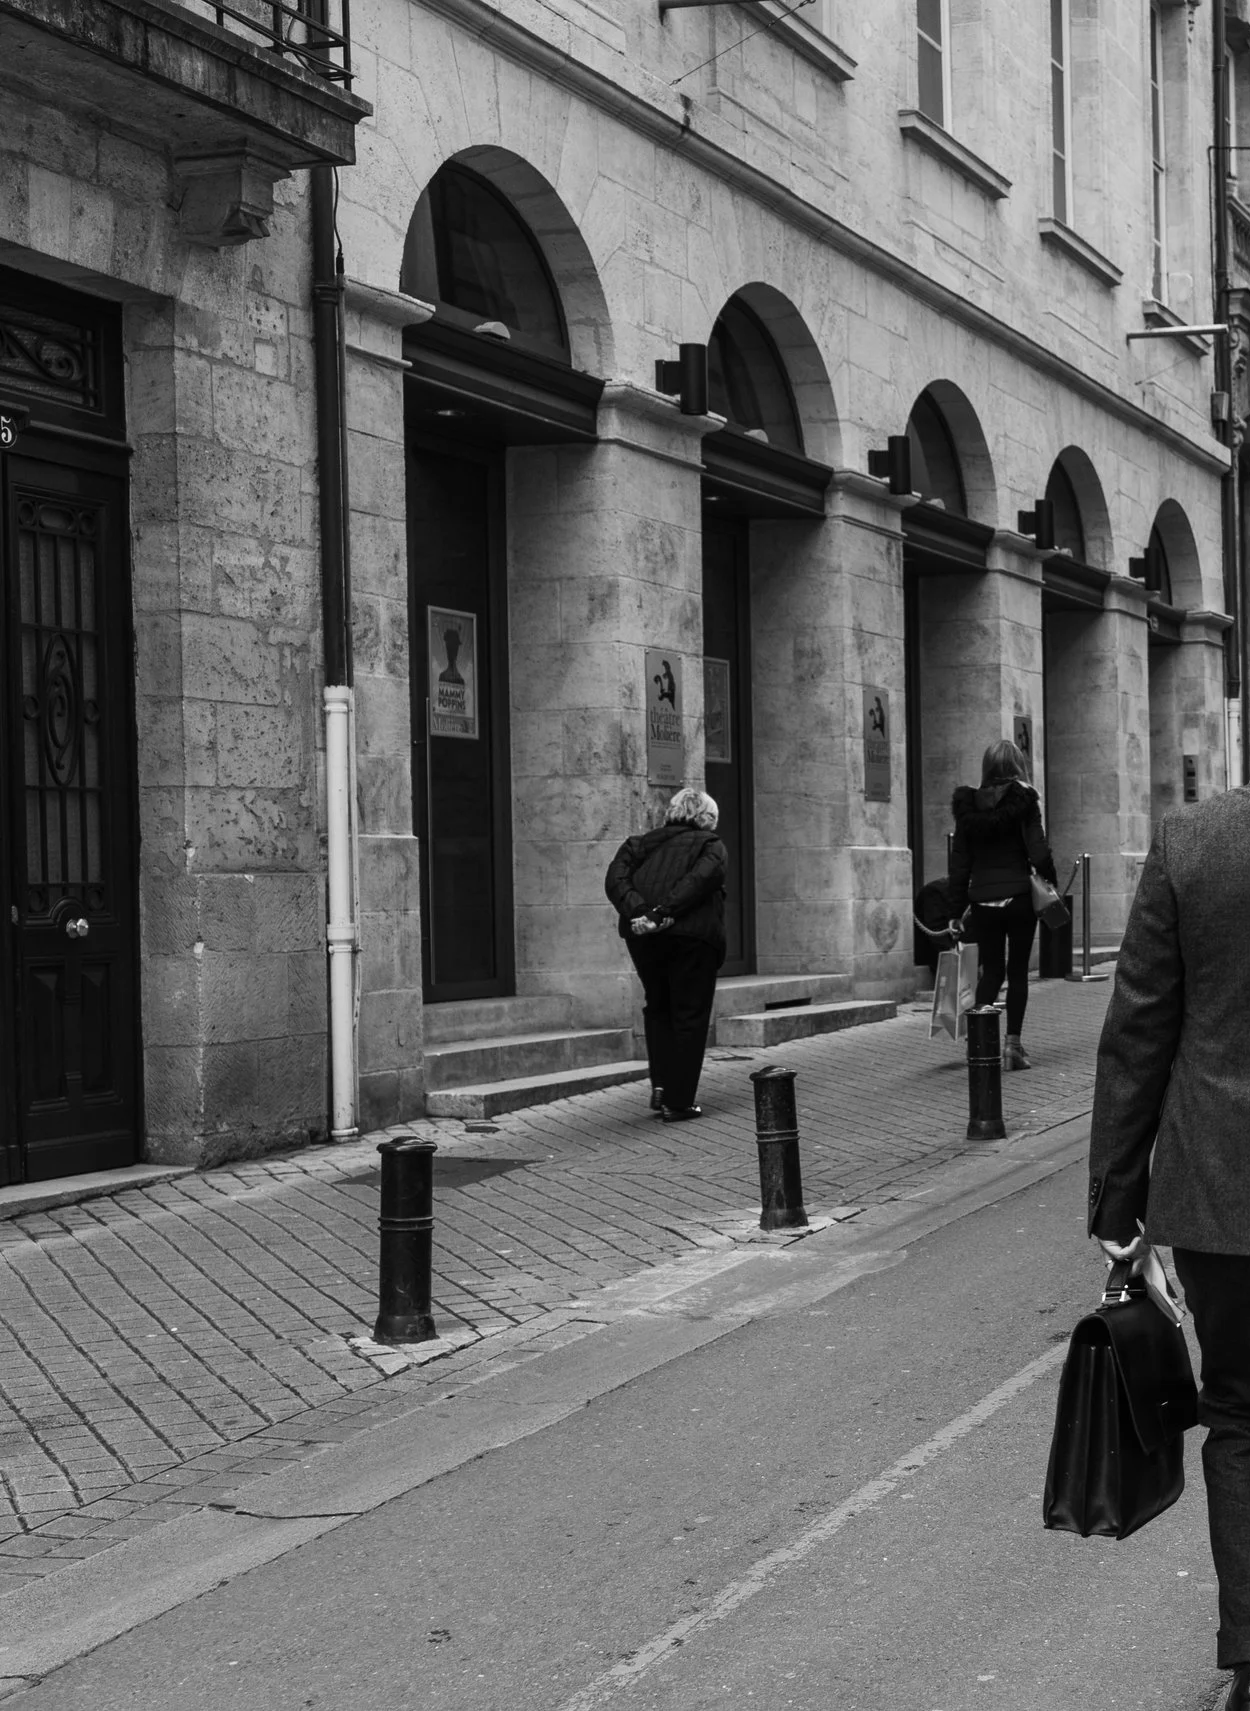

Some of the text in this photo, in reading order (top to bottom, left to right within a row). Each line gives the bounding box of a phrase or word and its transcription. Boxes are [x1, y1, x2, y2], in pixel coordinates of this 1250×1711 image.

[438, 687, 465, 700] MAMMY
[438, 697, 466, 710] POPPINS
[650, 723, 681, 743] Molière
